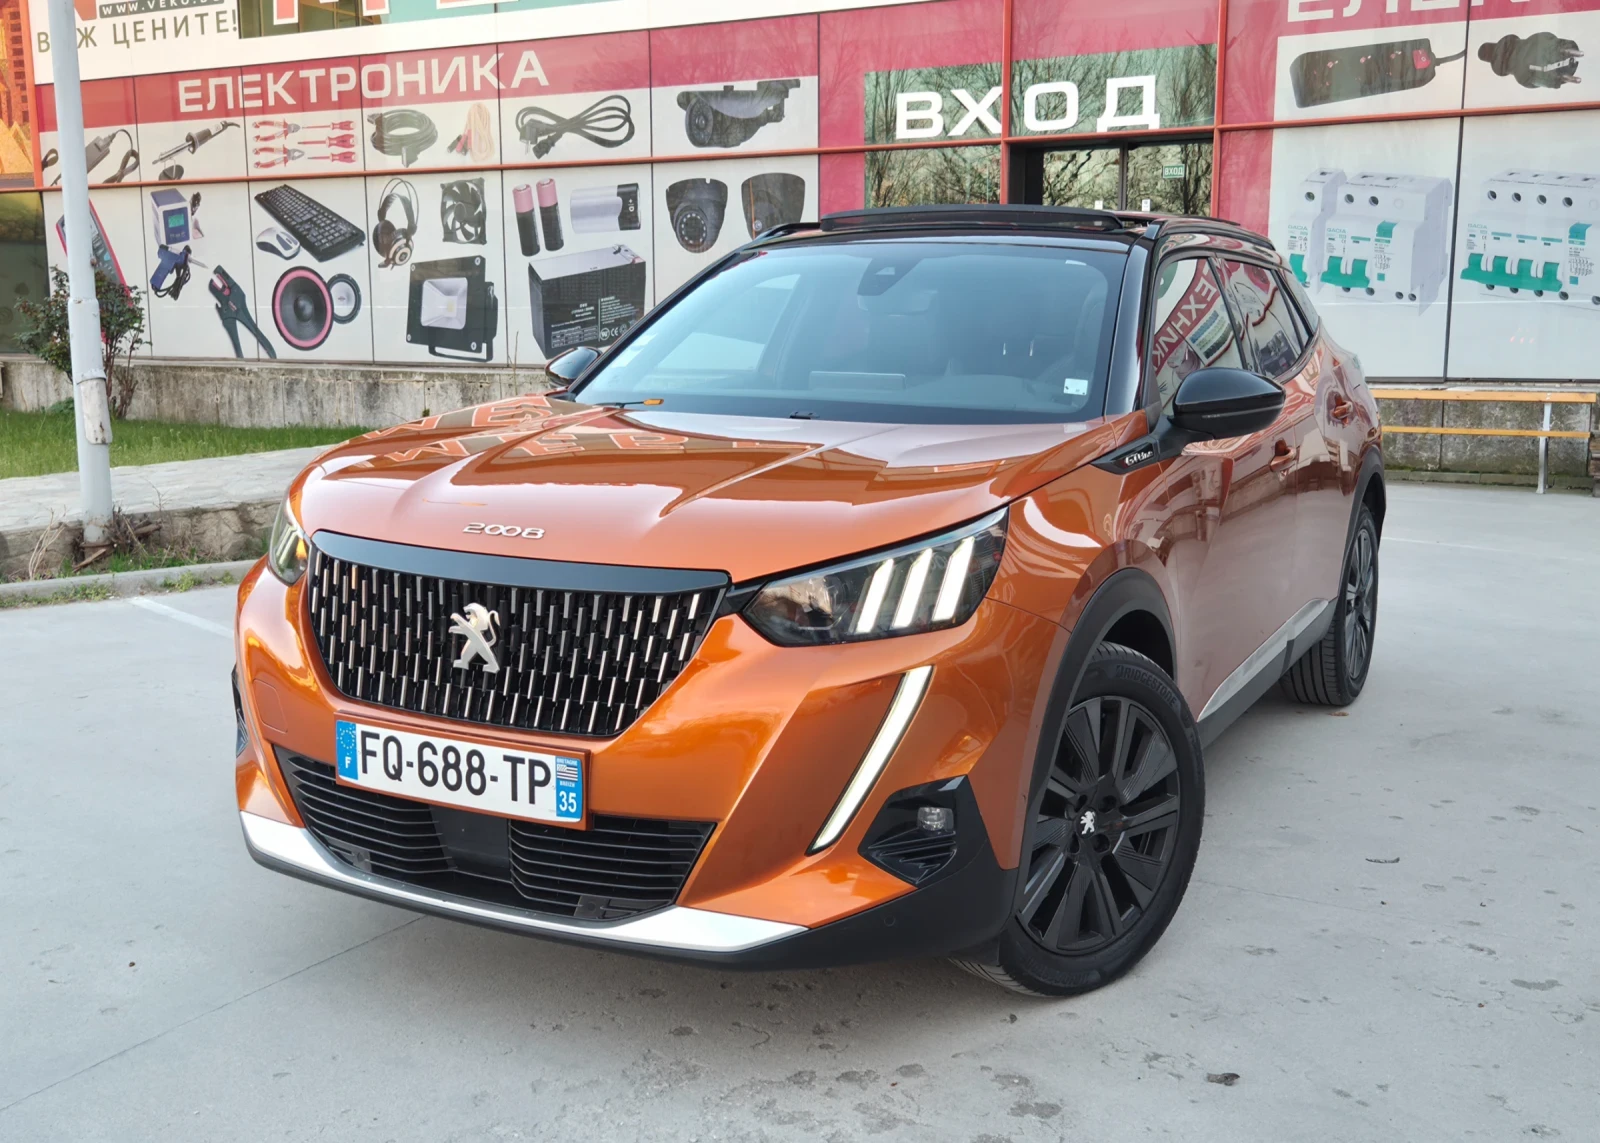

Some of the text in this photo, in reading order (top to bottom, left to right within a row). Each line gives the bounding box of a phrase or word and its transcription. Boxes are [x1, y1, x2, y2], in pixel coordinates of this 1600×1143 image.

[37, 26, 97, 52] ВЖ
[113, 10, 238, 48] ЦЕНИТЕ!
[178, 50, 549, 113] ЕЛЕКТРОНИКА
[896, 75, 1160, 139] ВХОД
[1164, 167, 1183, 176] ВХОД
[463, 522, 545, 539] 2008
[345, 730, 552, 804] F FQ-688-TP
[559, 790, 577, 813] 35
